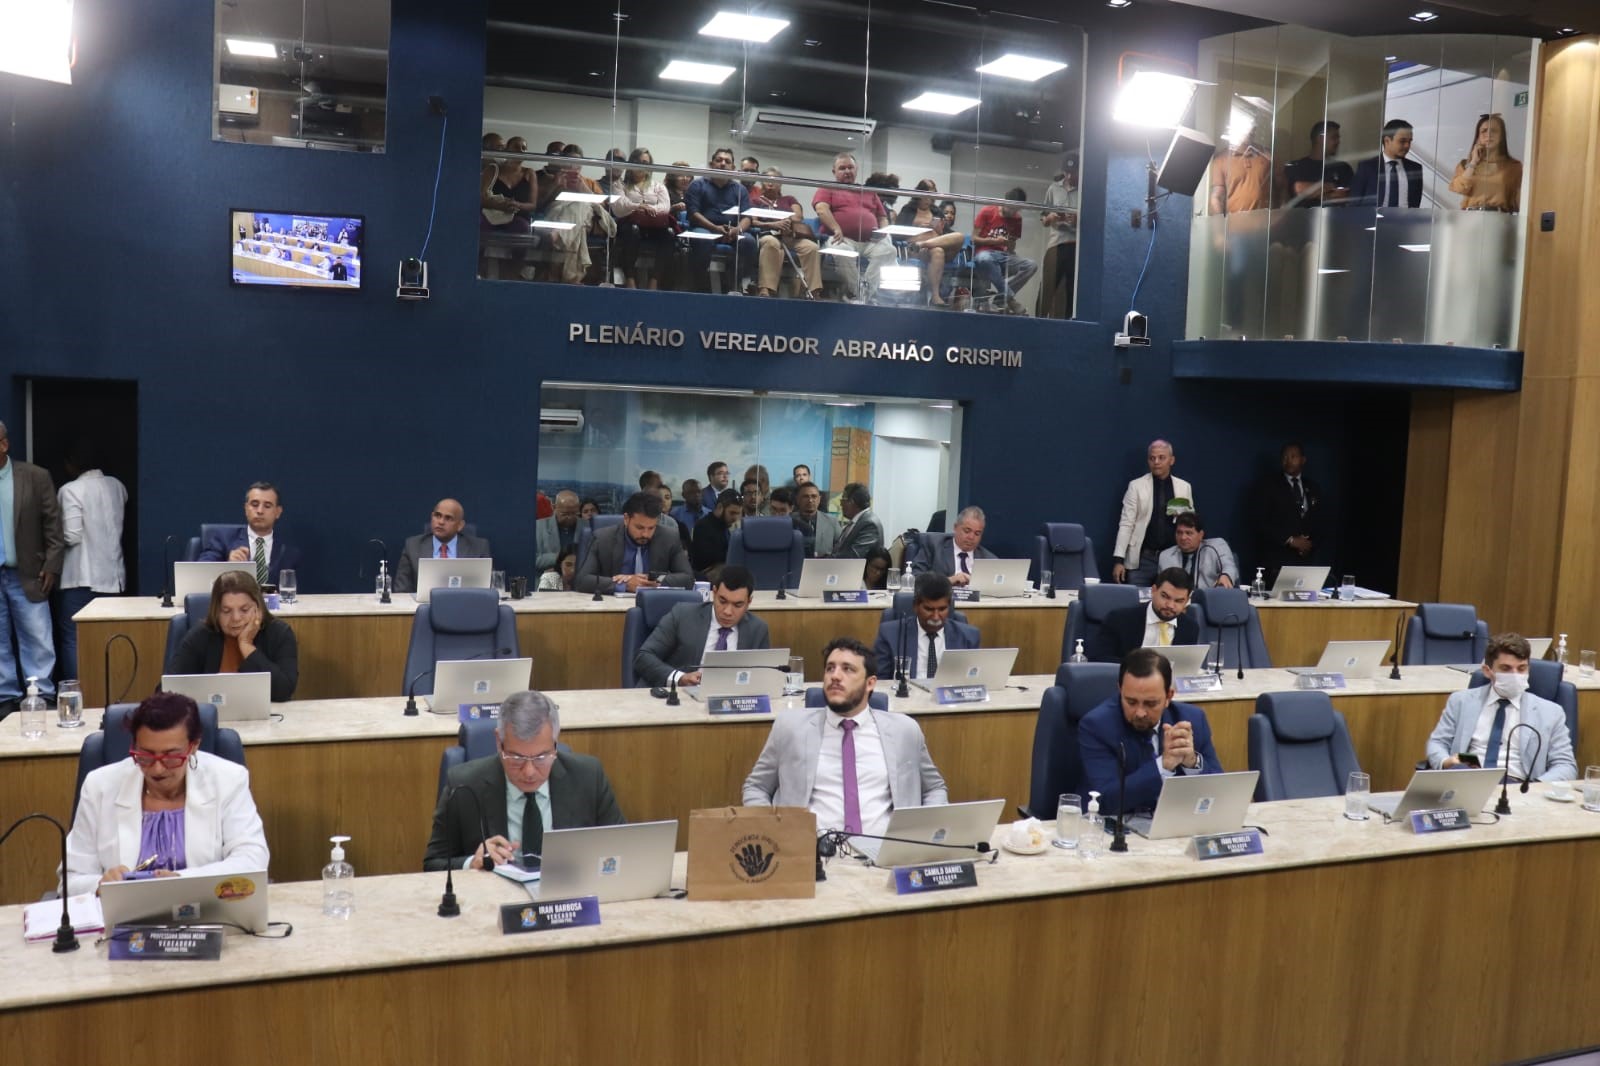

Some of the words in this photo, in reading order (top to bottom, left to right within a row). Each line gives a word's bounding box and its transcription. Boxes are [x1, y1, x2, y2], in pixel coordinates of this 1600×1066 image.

[569, 321, 685, 349] PLENÁRIO
[700, 330, 820, 355] VEREADOR
[832, 338, 934, 363] ABRAHÃO
[946, 346, 1023, 368] CRISPIM
[924, 866, 944, 877] CAMILO
[945, 865, 963, 875] DANIEL
[538, 904, 554, 914] IRAN
[554, 902, 582, 913] BARBOSA
